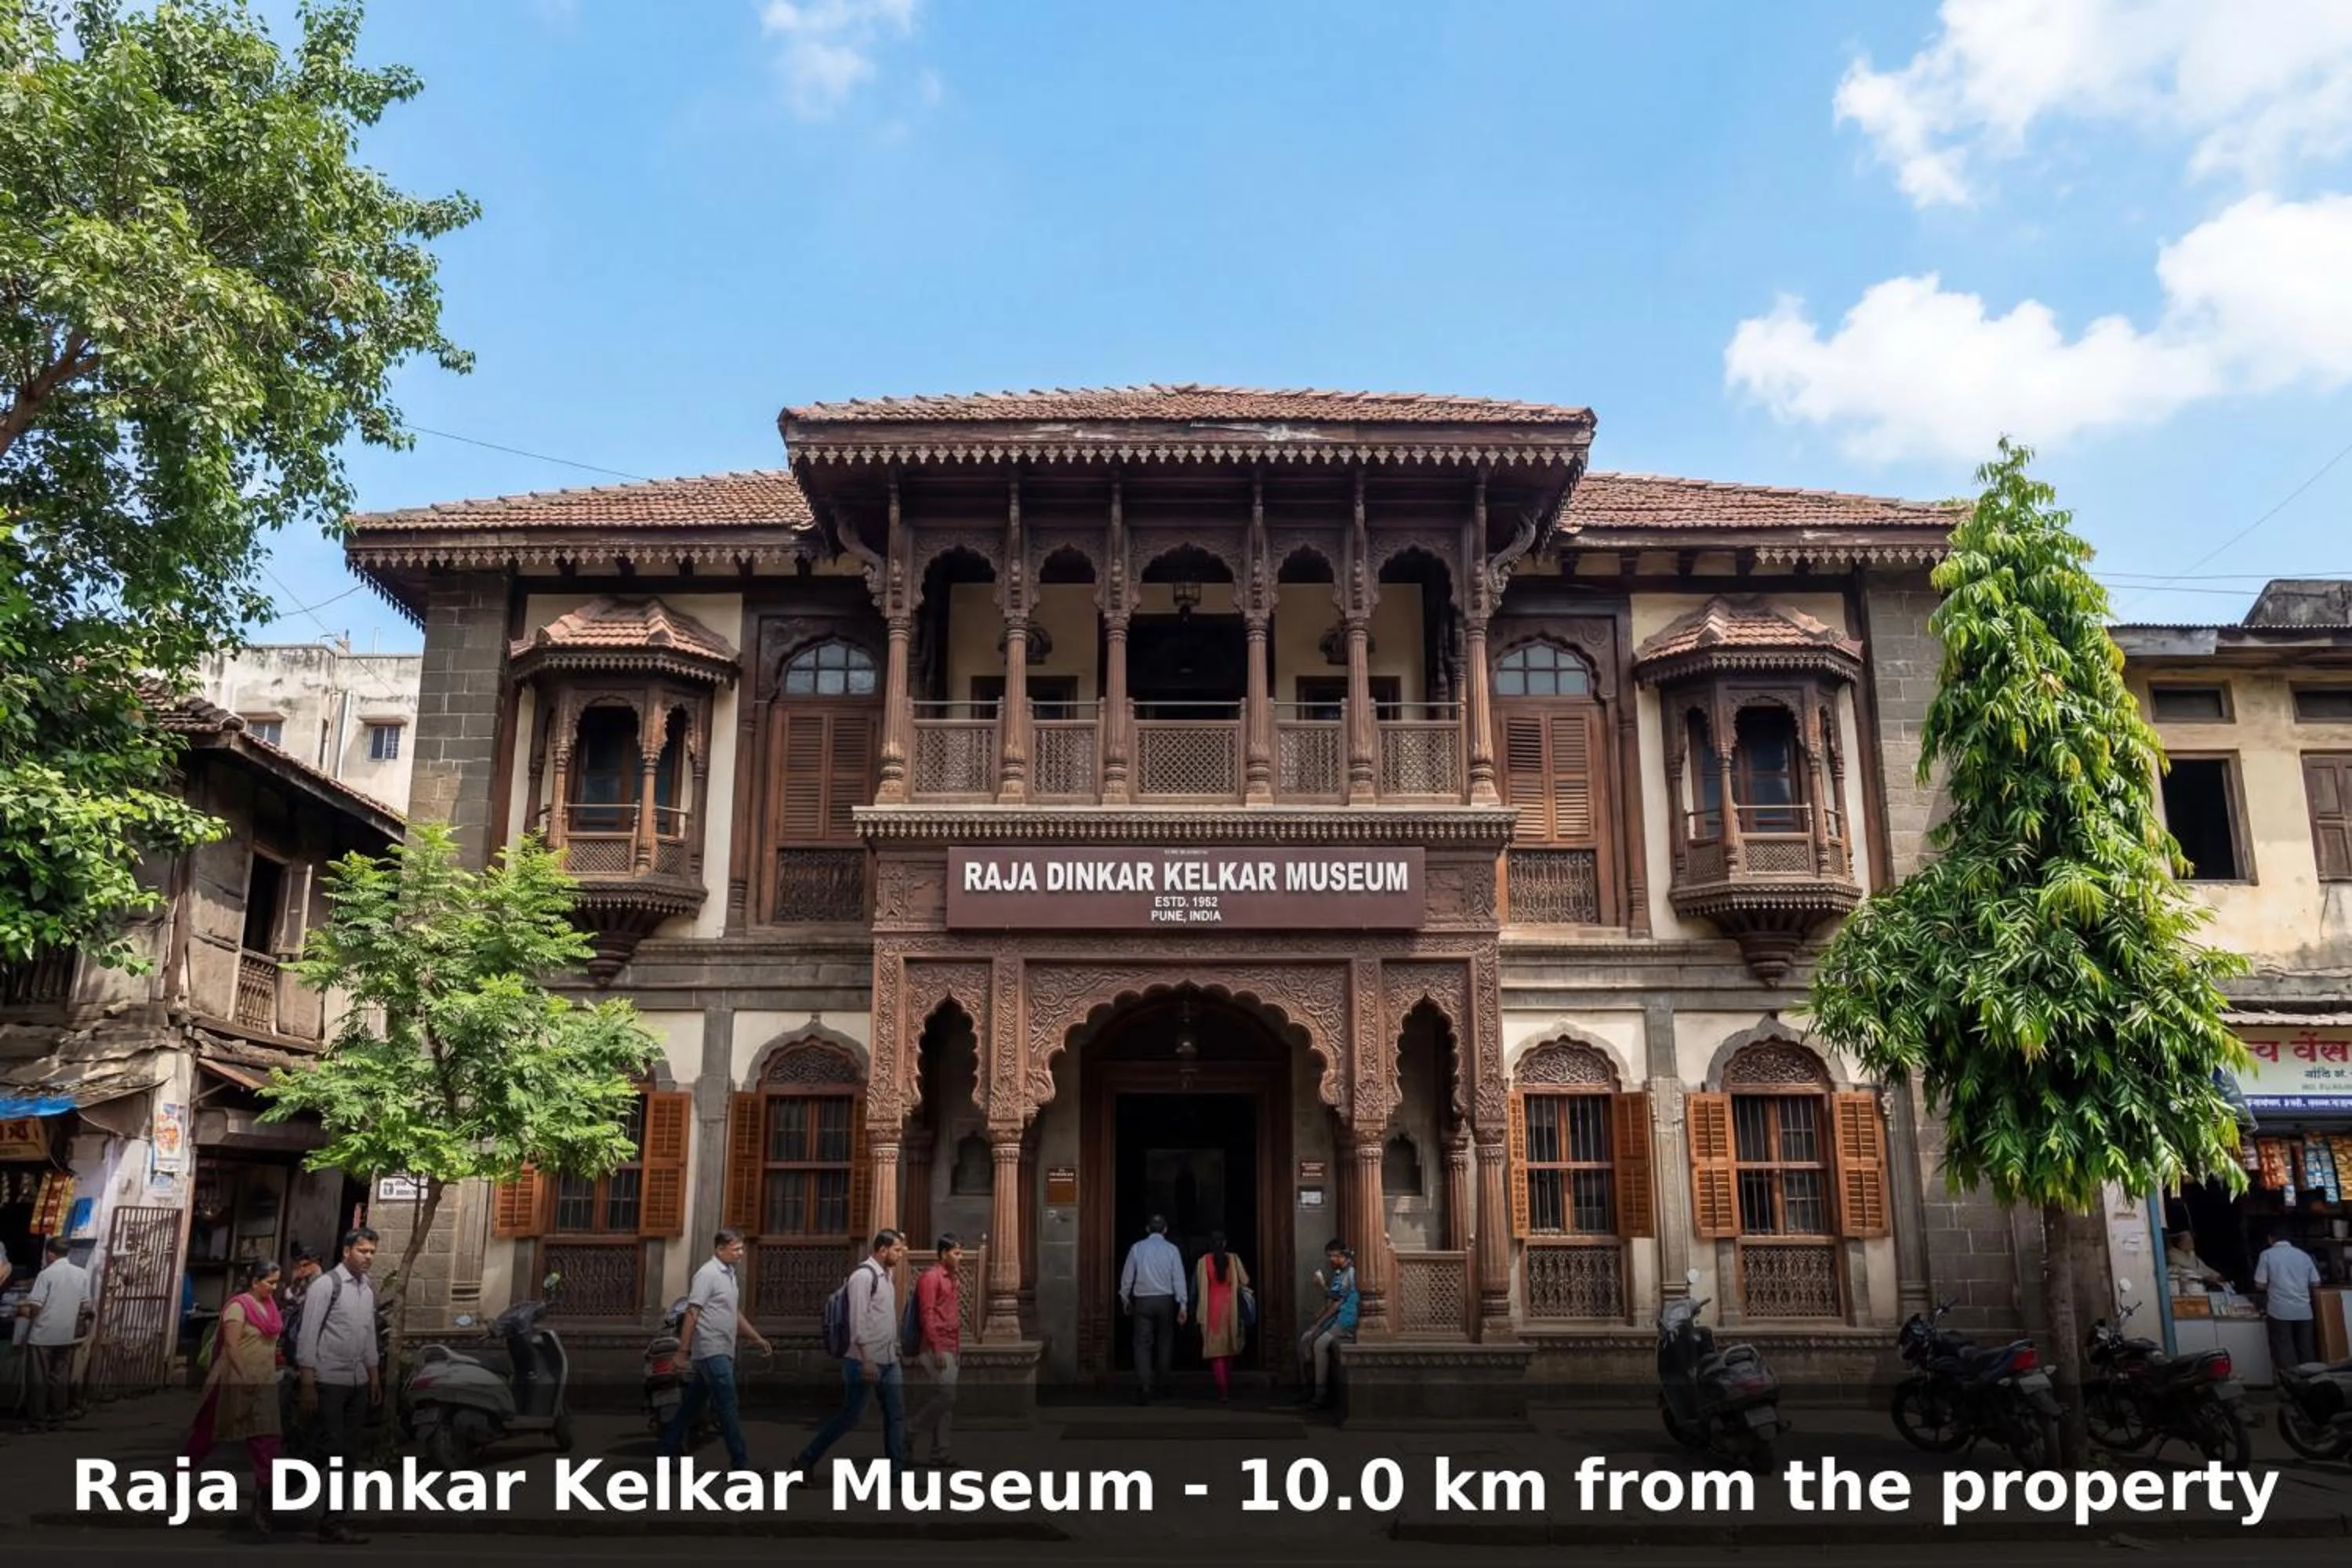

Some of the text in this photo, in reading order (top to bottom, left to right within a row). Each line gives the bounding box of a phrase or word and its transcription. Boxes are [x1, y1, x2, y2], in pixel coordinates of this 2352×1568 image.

[964, 862, 1408, 891] RAJA DINKAR KELKAR MUSEUM
[1155, 896, 1189, 907] ESTD.
[1151, 910, 1221, 923] PUNE, INDIA
